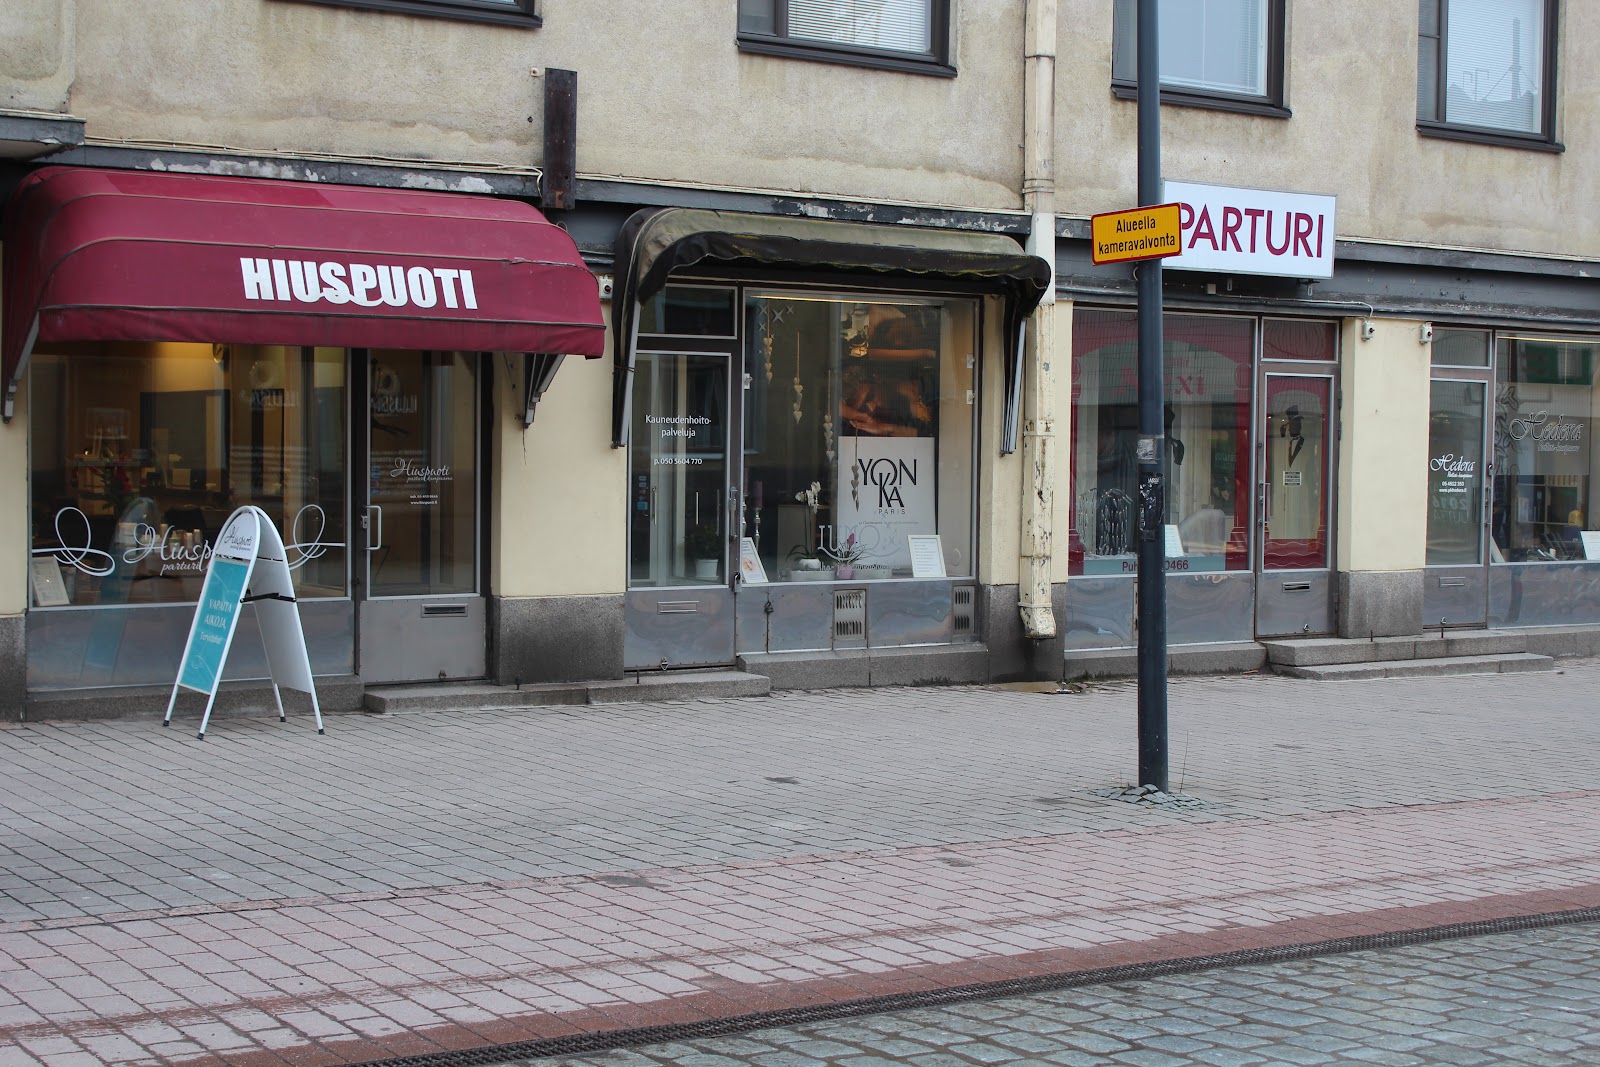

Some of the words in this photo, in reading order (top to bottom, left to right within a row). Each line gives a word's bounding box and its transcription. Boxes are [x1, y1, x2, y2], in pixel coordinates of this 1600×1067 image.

[1116, 216, 1156, 233] Alueella
[1181, 203, 1324, 258] PARTURI
[1098, 233, 1176, 254] kameravalvonta
[240, 257, 478, 310] HIUSPUOTI
[645, 414, 712, 424] Kauneudenhoito-
[1509, 410, 1584, 441] Hedera
[661, 427, 696, 438] palveluja
[390, 457, 450, 481] Hiuspuoti
[858, 458, 917, 486] YON
[1430, 453, 1475, 471] Hedera
[879, 472, 905, 508] KA
[209, 599, 232, 612] VAPAITA
